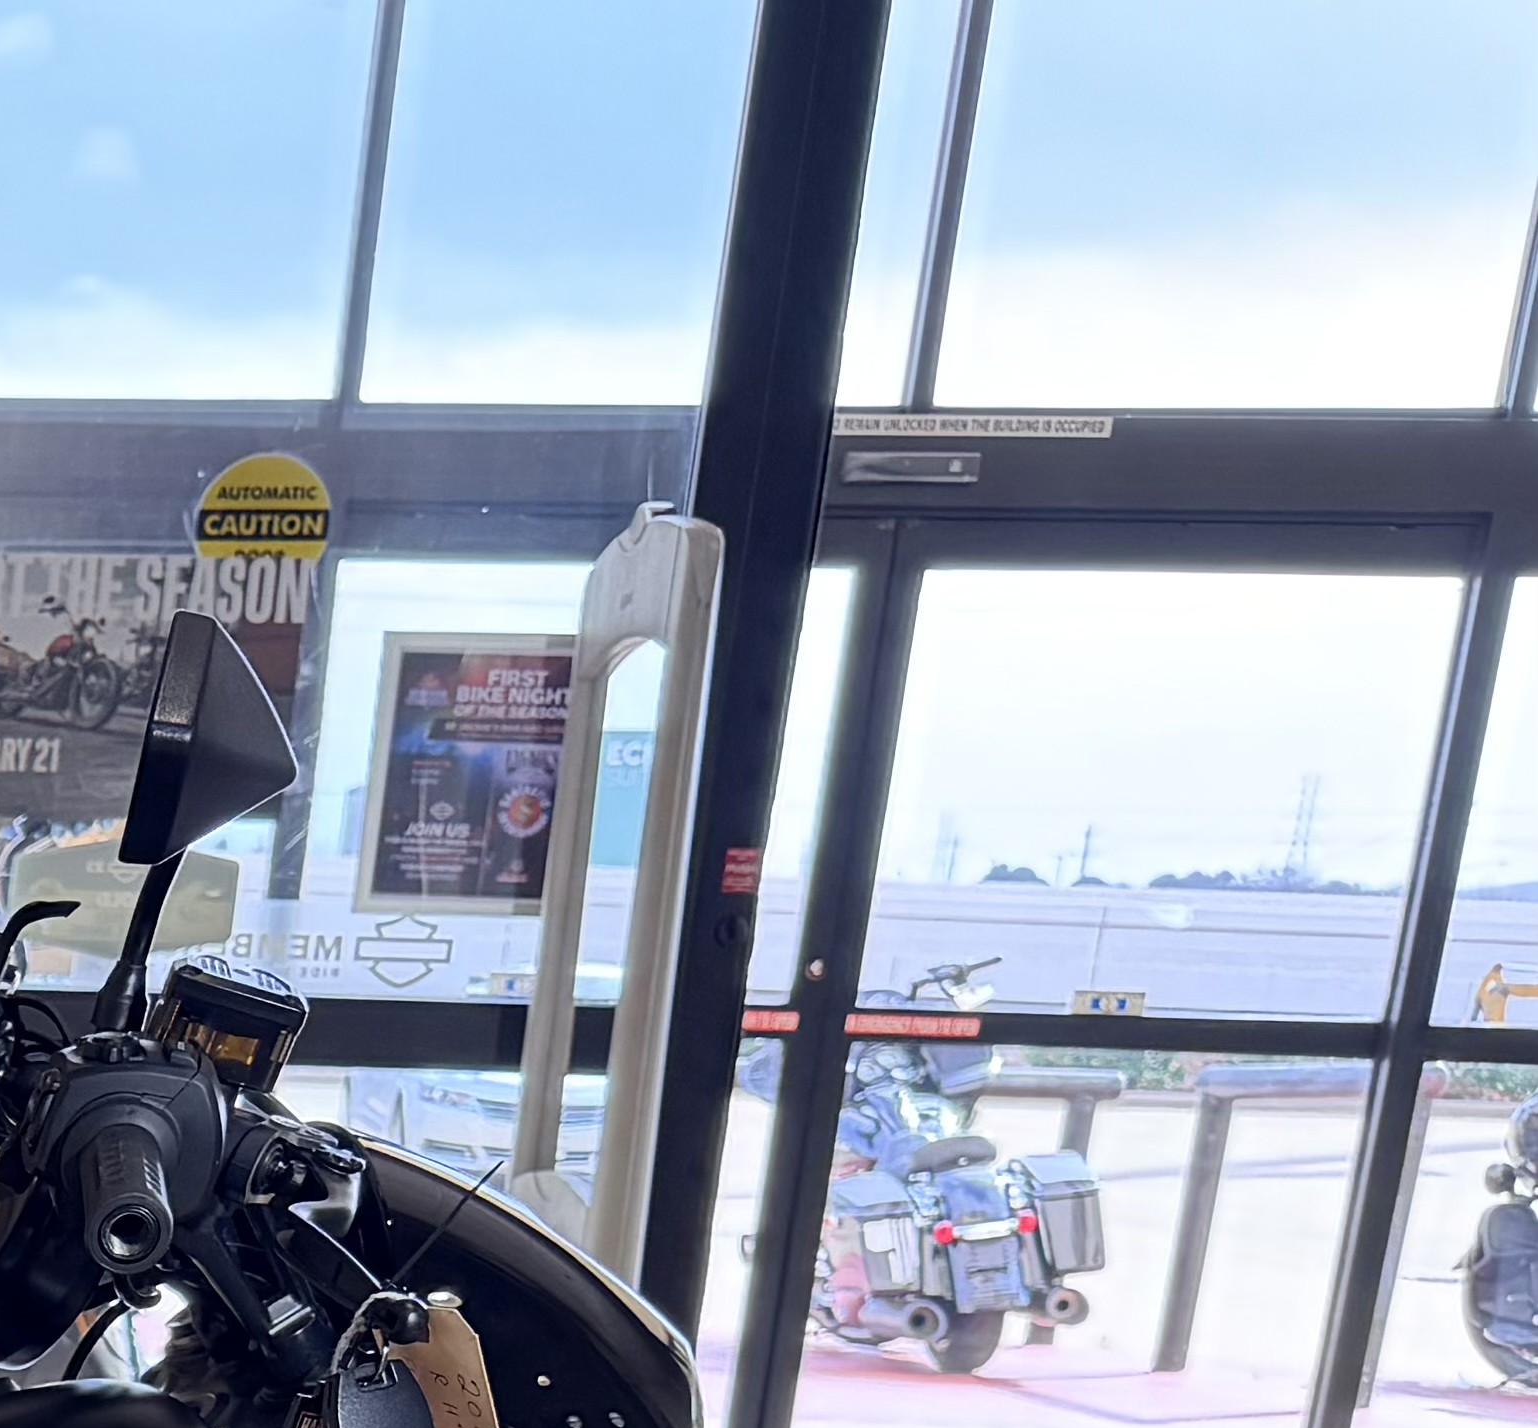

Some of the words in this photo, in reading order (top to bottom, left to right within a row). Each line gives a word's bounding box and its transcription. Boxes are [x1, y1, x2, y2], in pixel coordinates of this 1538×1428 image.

[884, 418, 936, 432] UNLOCKED
[939, 419, 968, 432] WHEN
[971, 419, 991, 432] THE
[993, 419, 1040, 433] BUILDING
[1054, 419, 1105, 434] OCCUPIED
[216, 485, 319, 501] AUTOMATIC
[203, 513, 325, 537] CAUTION
[44, 556, 126, 620] THE
[133, 556, 319, 625] SEASON
[487, 668, 550, 688] FIRST
[455, 684, 505, 704] BIKE
[507, 686, 571, 706] NIGHT
[32, 738, 60, 773] 21
[404, 821, 445, 838] JOIN
